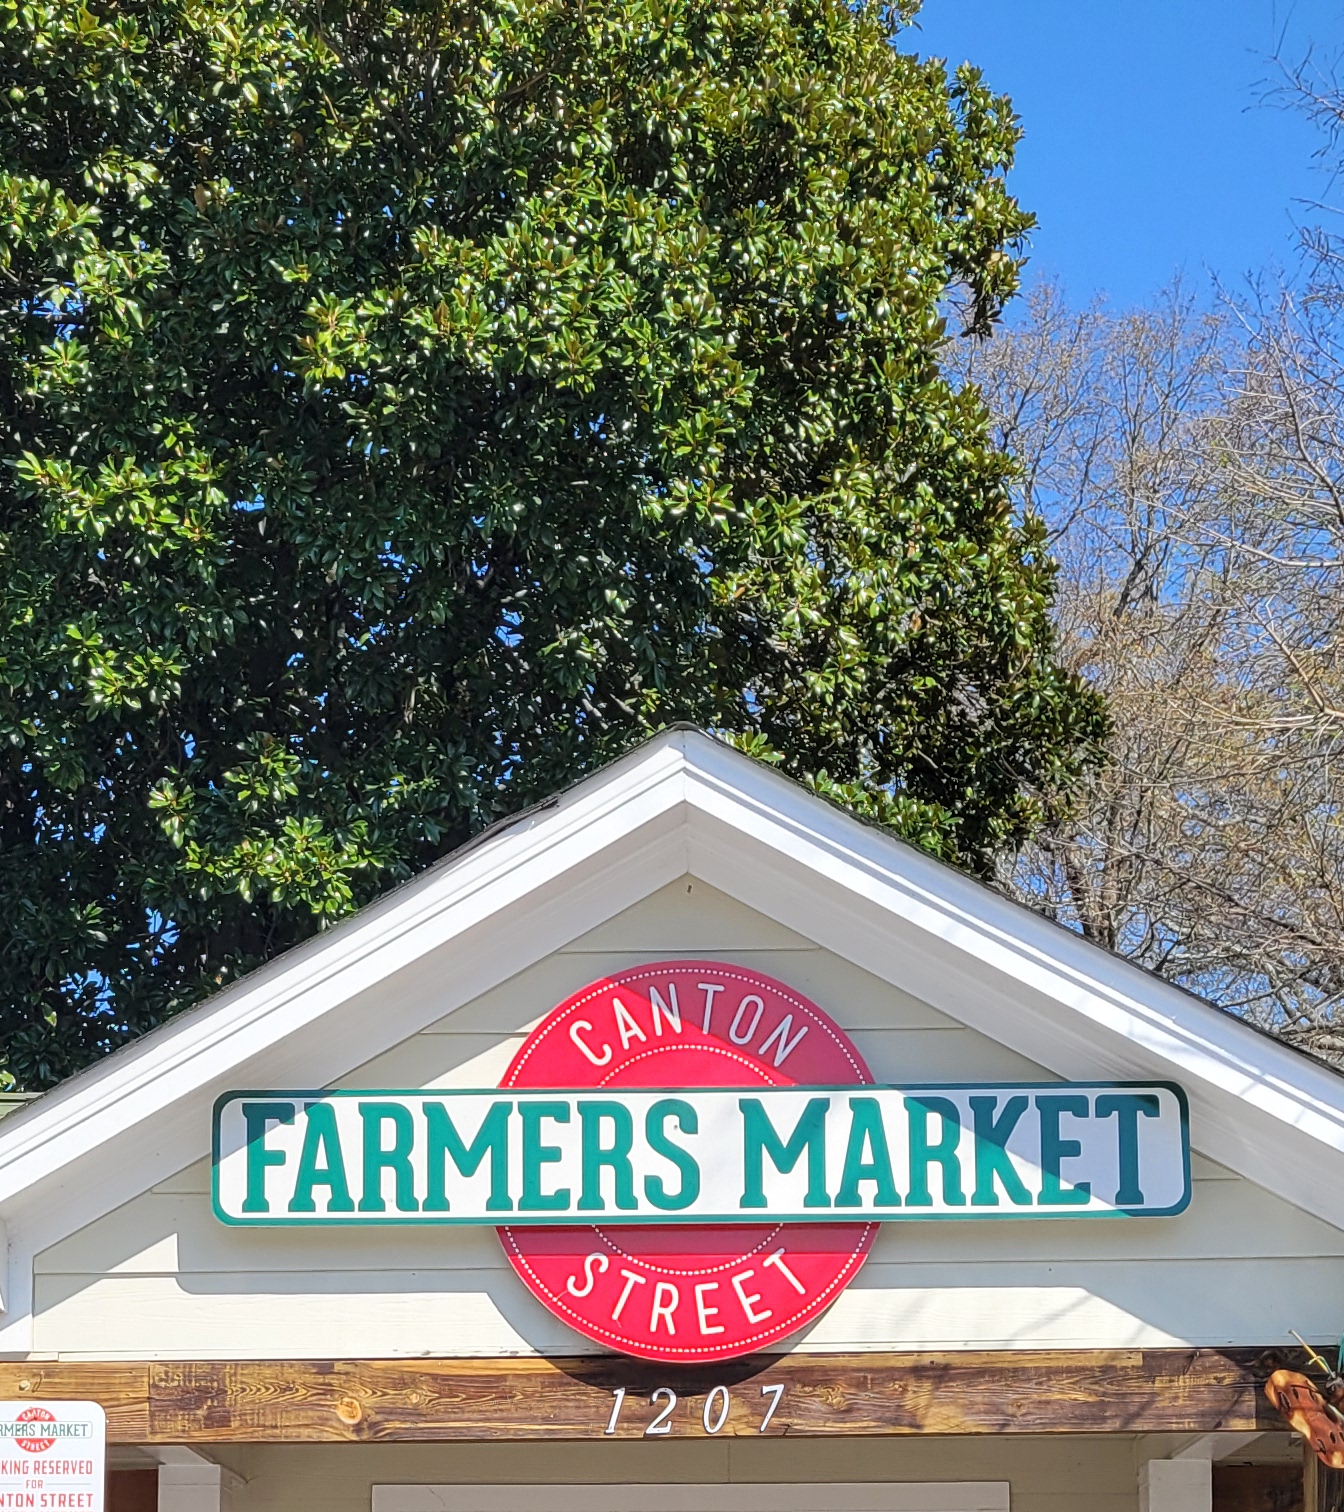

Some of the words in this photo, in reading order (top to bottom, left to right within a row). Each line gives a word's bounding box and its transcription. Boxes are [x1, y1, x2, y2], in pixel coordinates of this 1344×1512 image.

[568, 982, 809, 1068] CANTON
[242, 1098, 701, 1214] FARMERS
[738, 1094, 1160, 1210] MARKET
[566, 1247, 800, 1337] STREET
[21, 1409, 51, 1421] CANTON
[604, 1384, 787, 1436] 1207
[40, 1423, 89, 1437] MARKET
[21, 1439, 50, 1451] STREET
[34, 1460, 93, 1475] RESERVED
[25, 1479, 44, 1489] FOR
[41, 1493, 94, 1508] STREET
